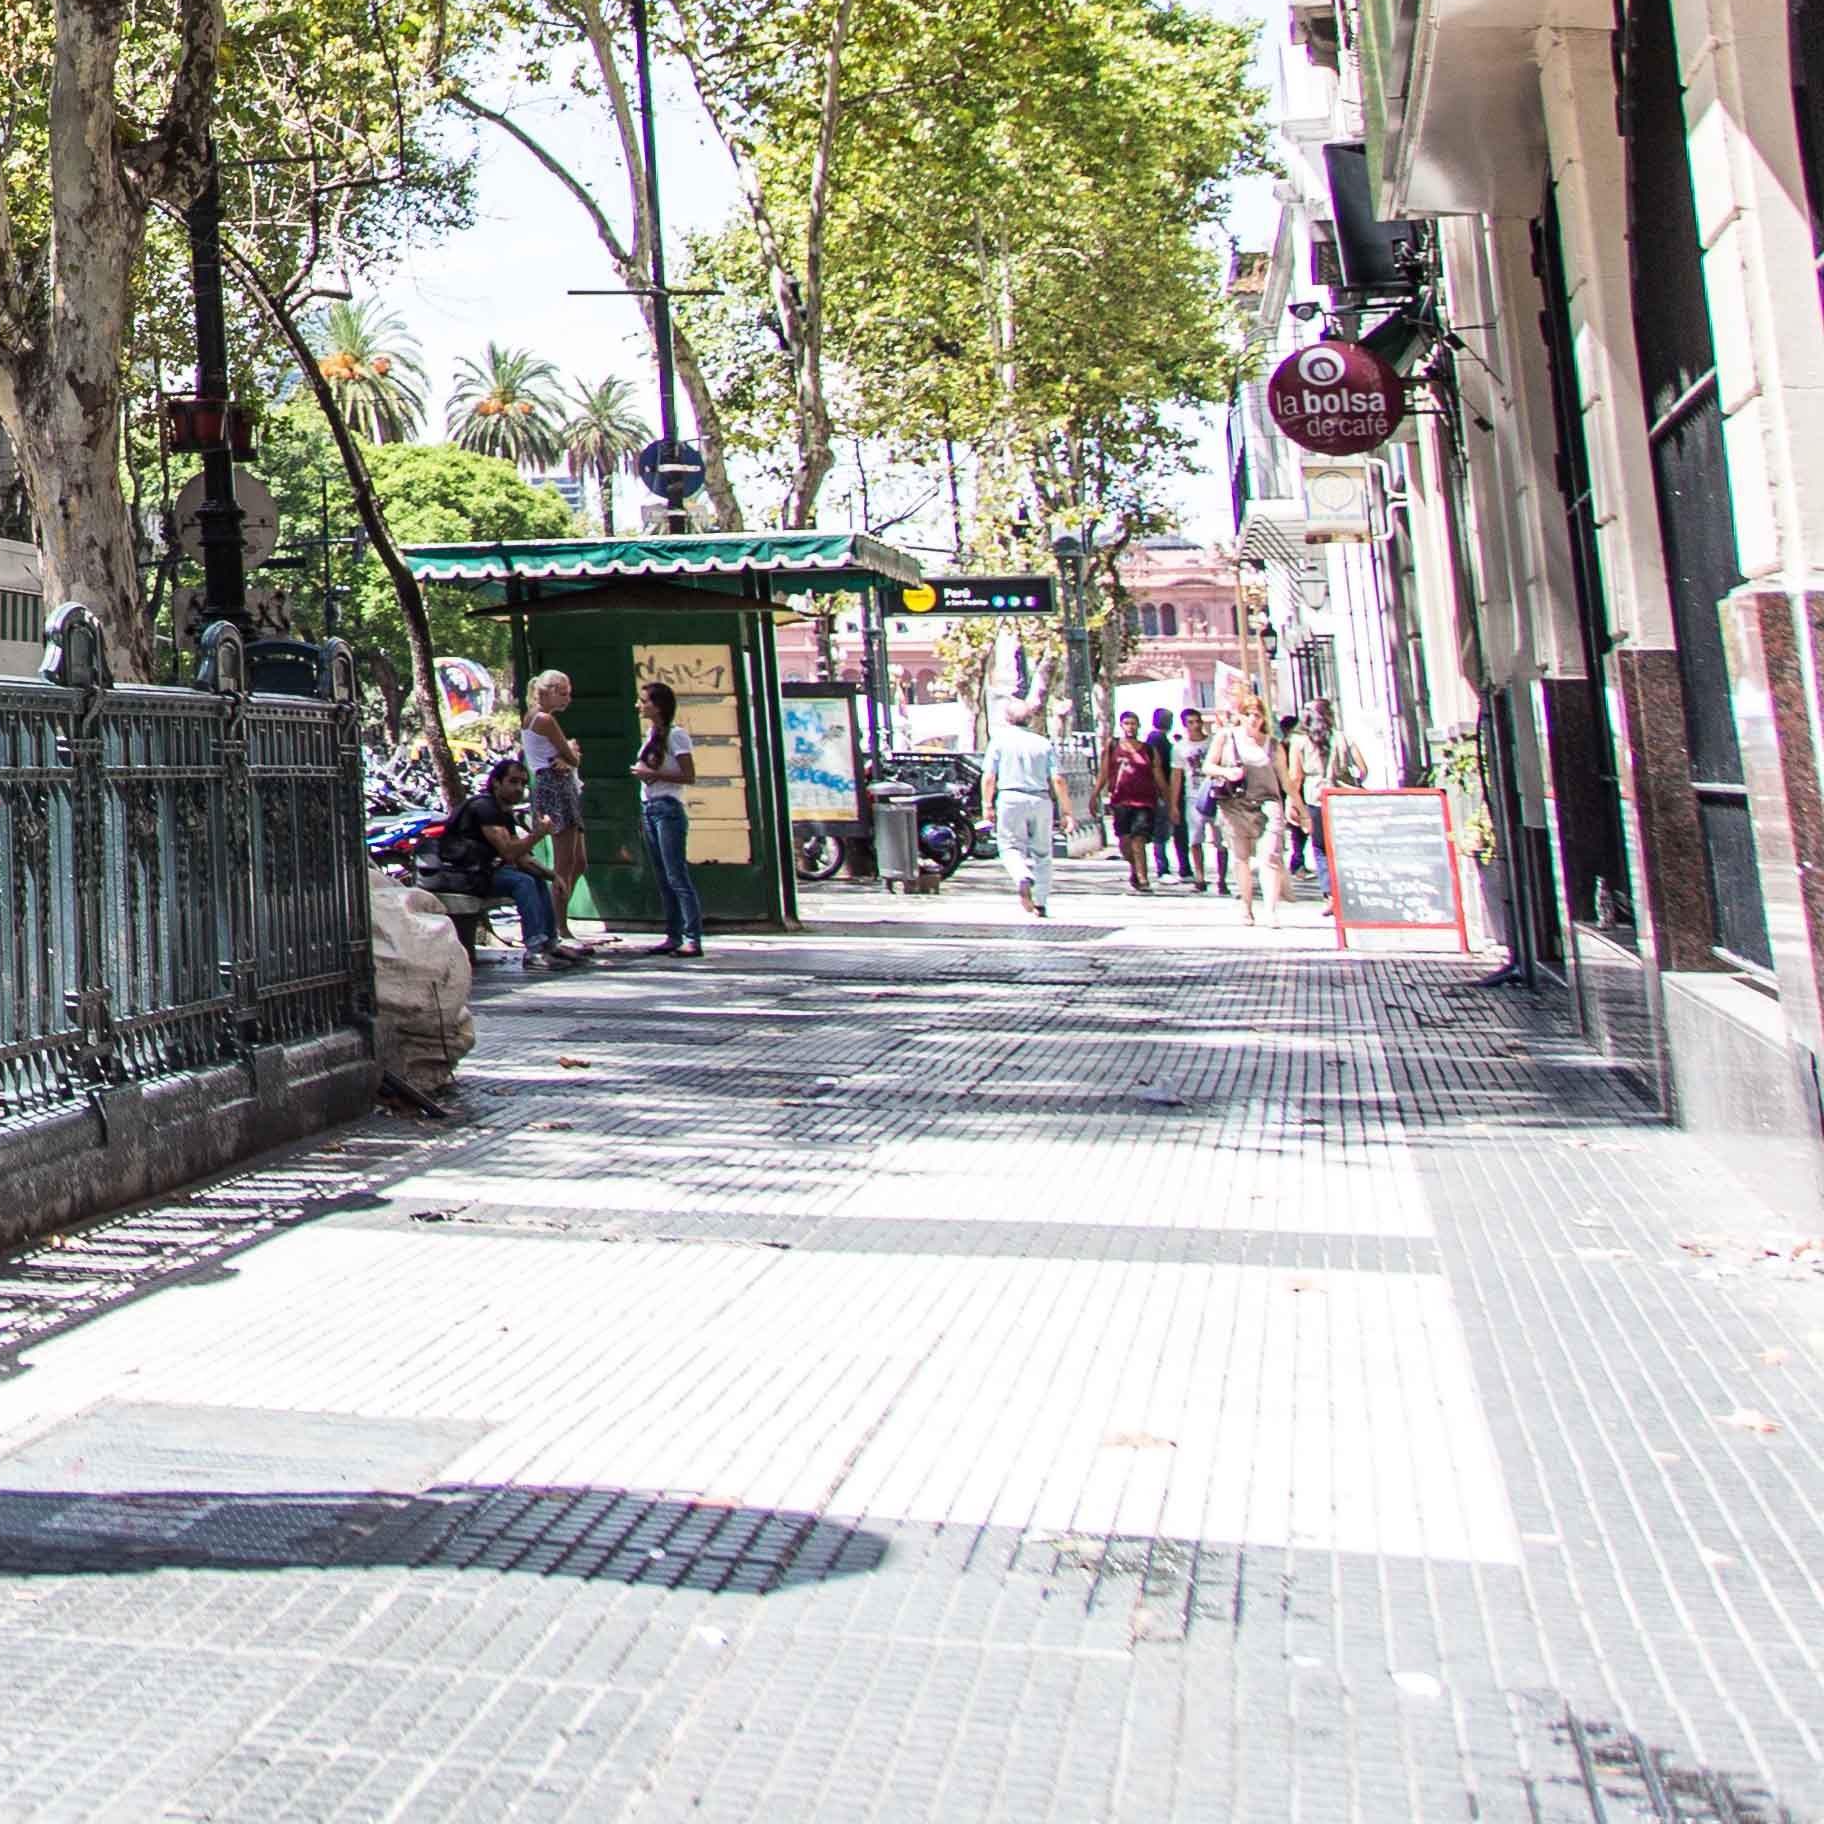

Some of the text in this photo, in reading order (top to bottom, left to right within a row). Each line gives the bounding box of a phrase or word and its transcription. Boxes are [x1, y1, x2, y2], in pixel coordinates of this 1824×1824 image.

[1276, 389, 1387, 416] la bolsa
[1307, 415, 1389, 438] de café
